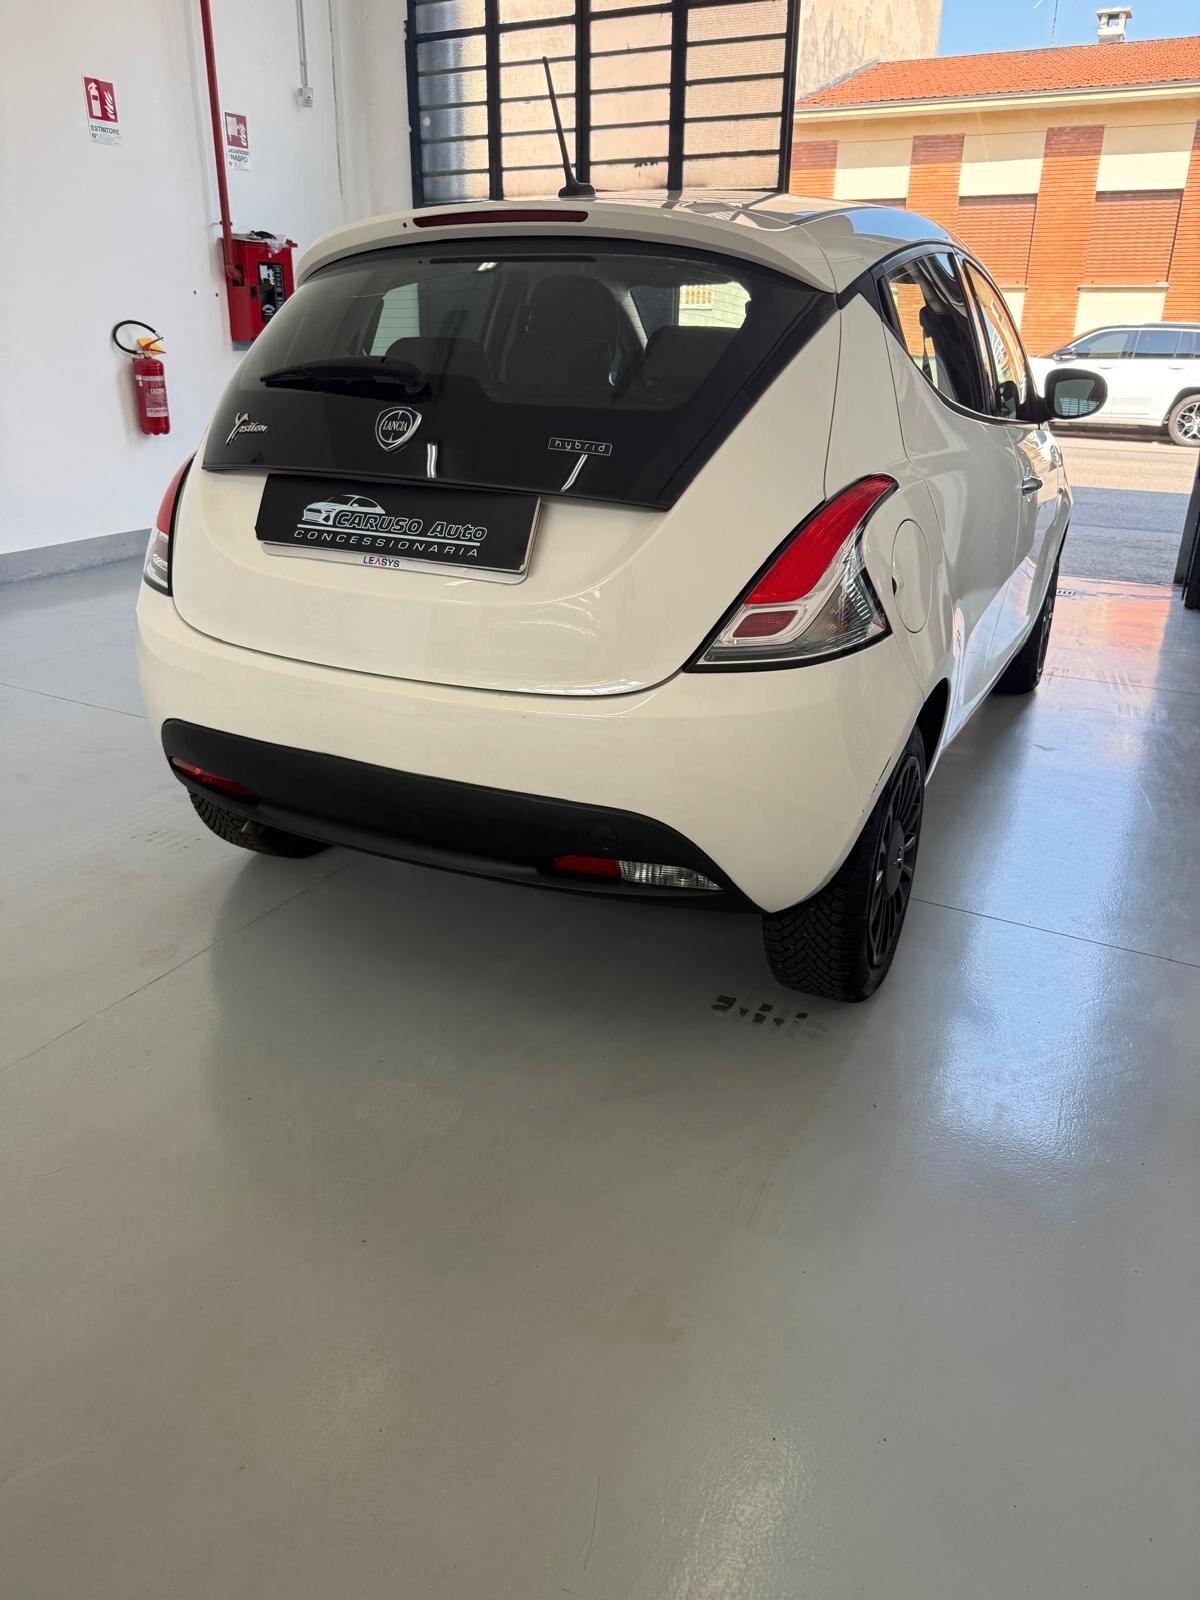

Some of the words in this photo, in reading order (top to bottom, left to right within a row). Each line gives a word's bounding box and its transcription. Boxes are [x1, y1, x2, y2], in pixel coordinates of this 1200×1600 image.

[90, 125, 120, 135] ESTINTORE
[225, 412, 269, 446] Ypsilon
[382, 419, 408, 432] LANCIA
[555, 439, 606, 452] hybrid
[335, 511, 424, 535] CARUSO
[428, 520, 488, 541] Auto
[293, 529, 479, 557] CONCESSIONARIA
[363, 555, 400, 568] LEASYS
